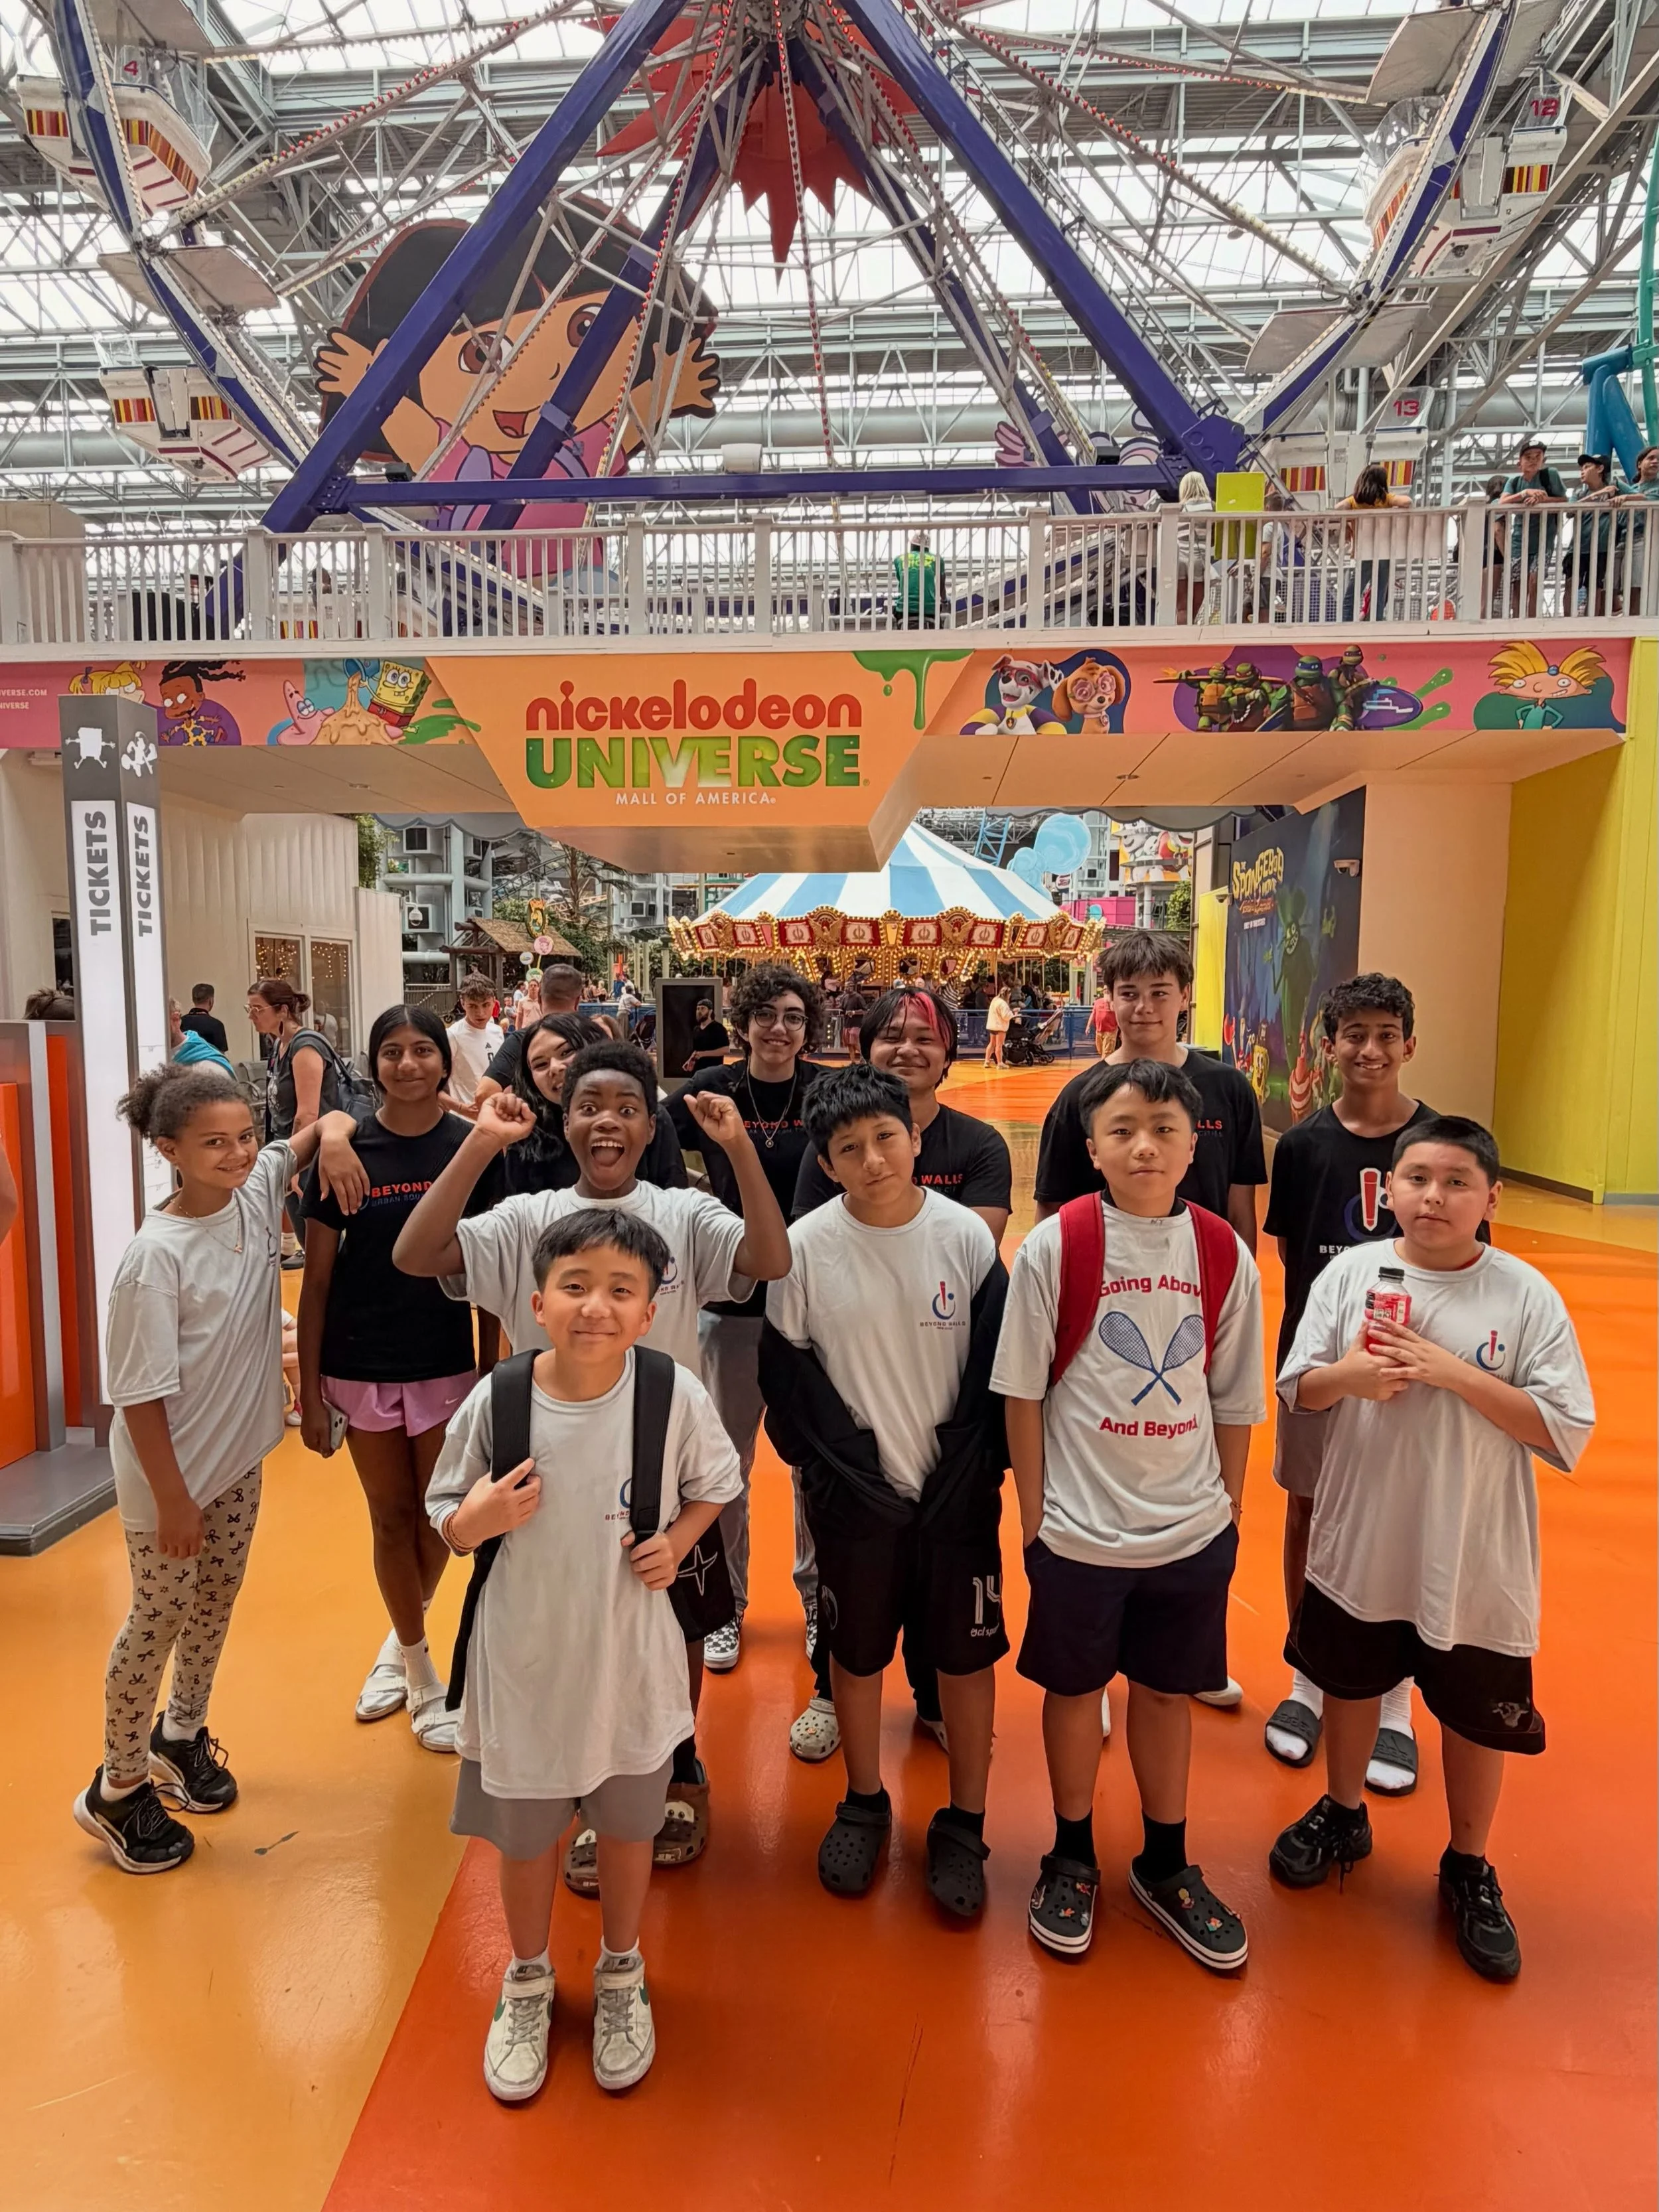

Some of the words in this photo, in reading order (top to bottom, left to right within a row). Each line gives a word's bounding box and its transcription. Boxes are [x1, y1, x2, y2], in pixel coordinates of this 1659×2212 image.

[124, 60, 138, 76] 4
[1530, 98, 1559, 117] 12
[1393, 400, 1419, 417] 13
[526, 678, 862, 731] nickelodeon
[615, 792, 657, 805] MALL
[666, 792, 687, 805] OF
[84, 811, 111, 936] TICKETS
[133, 815, 153, 937] TICKETS
[1197, 1119, 1222, 1130] LLS
[372, 1181, 433, 1198] BEYOND
[1100, 1276, 1152, 1298] Going
[1157, 1274, 1202, 1297] Abov
[1100, 1416, 1139, 1436] And
[972, 1572, 1001, 1625] 14
